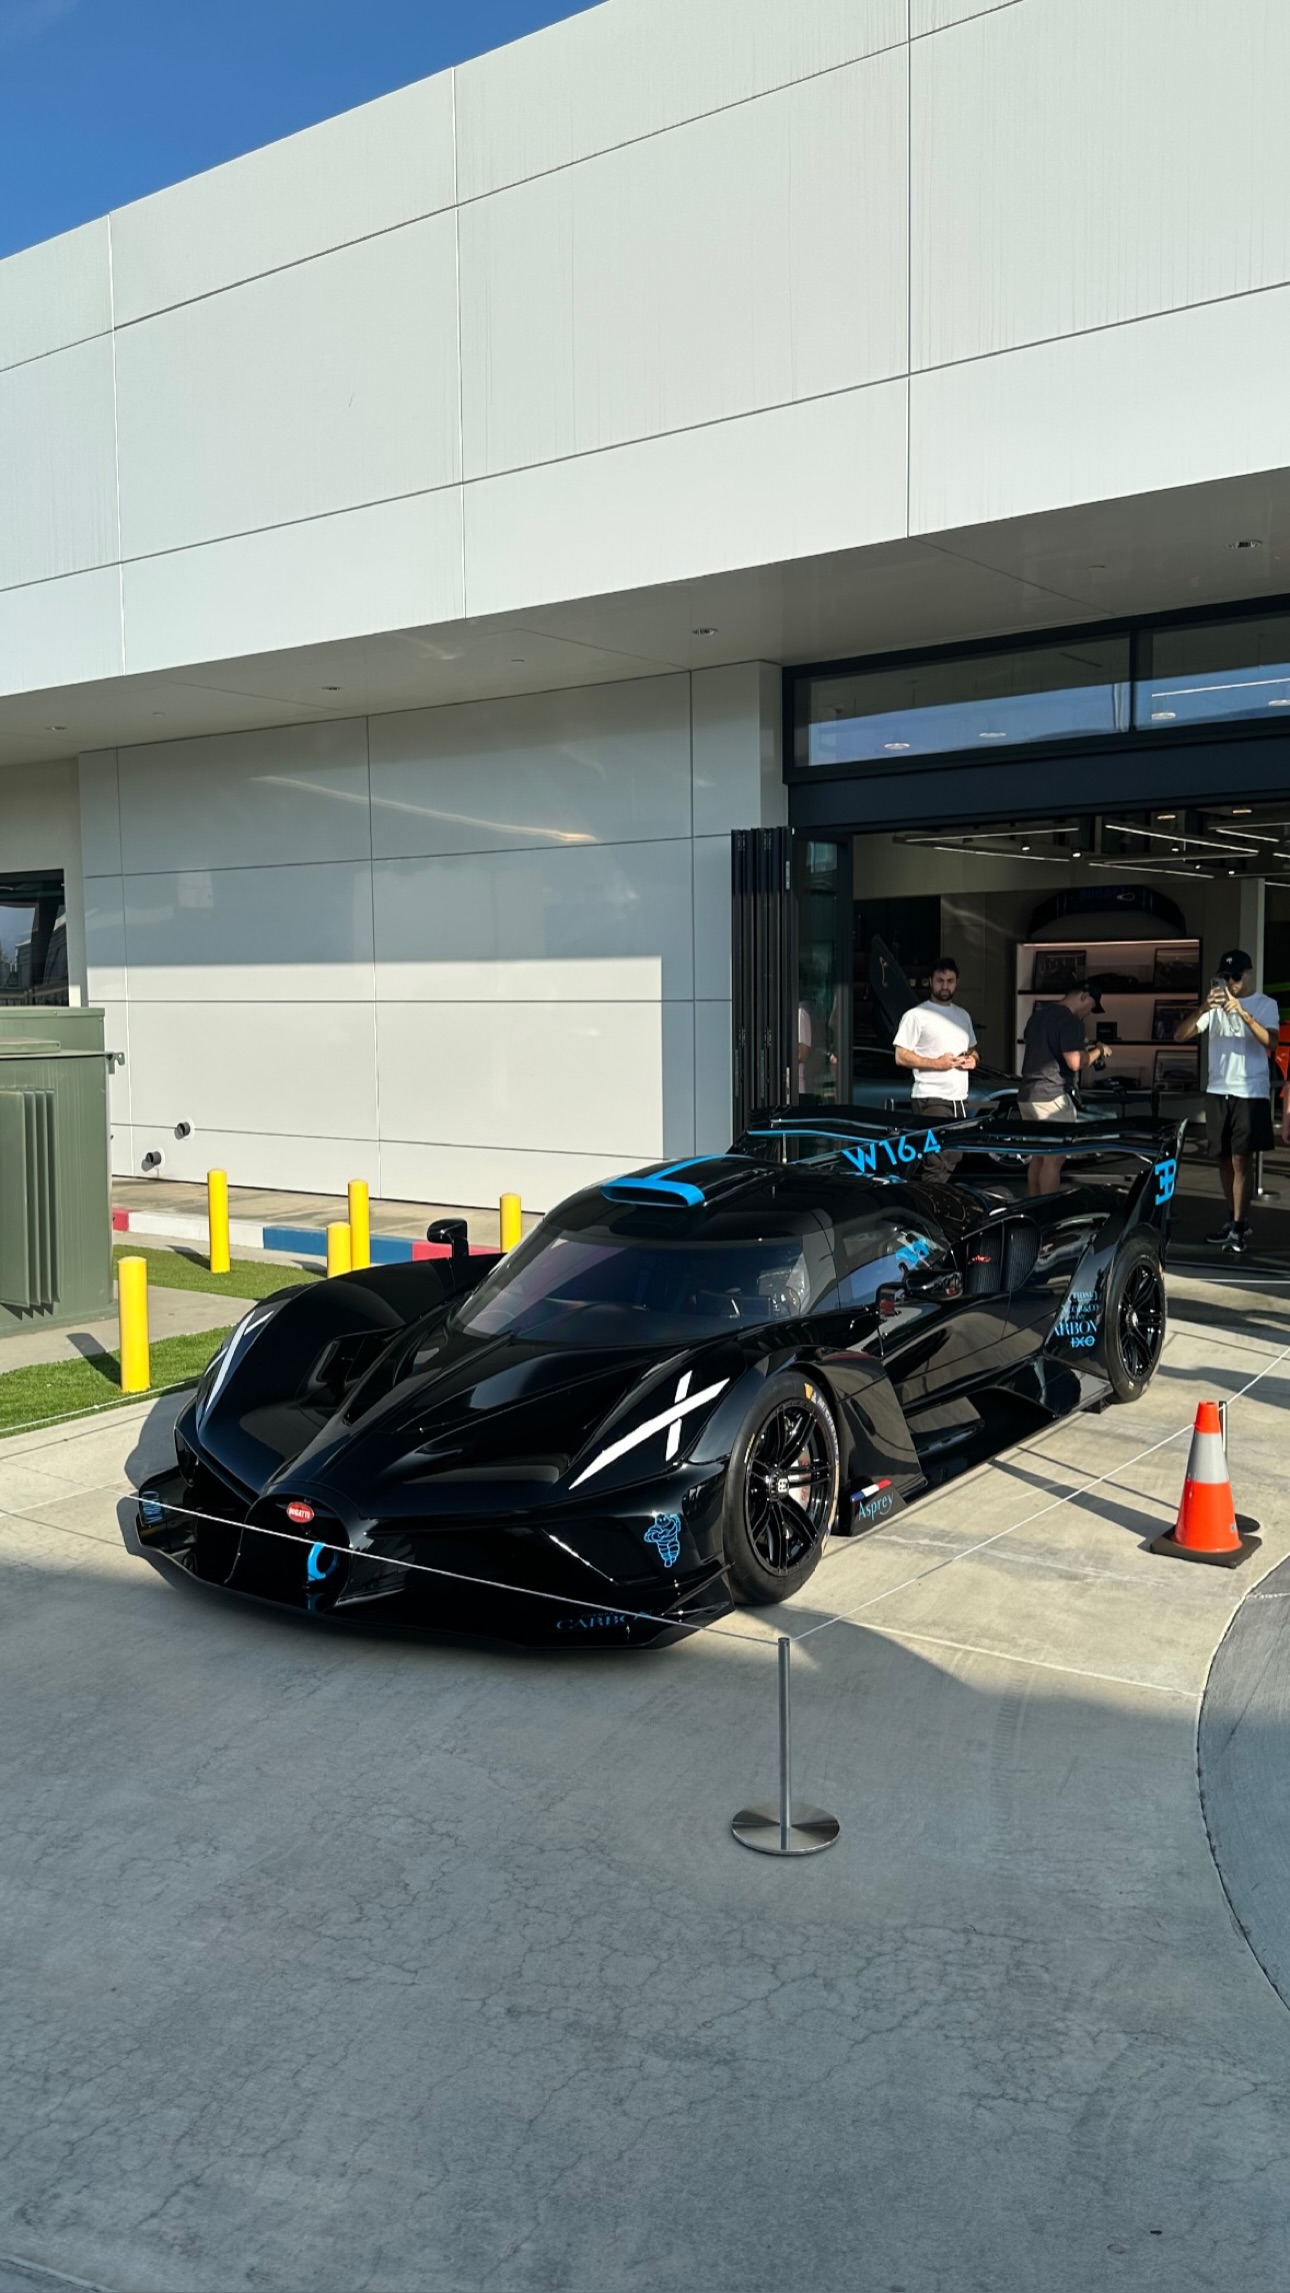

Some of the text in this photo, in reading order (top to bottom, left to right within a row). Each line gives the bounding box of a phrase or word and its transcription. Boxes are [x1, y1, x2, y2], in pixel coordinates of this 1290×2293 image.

[841, 1128, 941, 1173] W16.4
[1054, 1320, 1097, 1336] ARBON
[858, 1490, 894, 1521] Asprey
